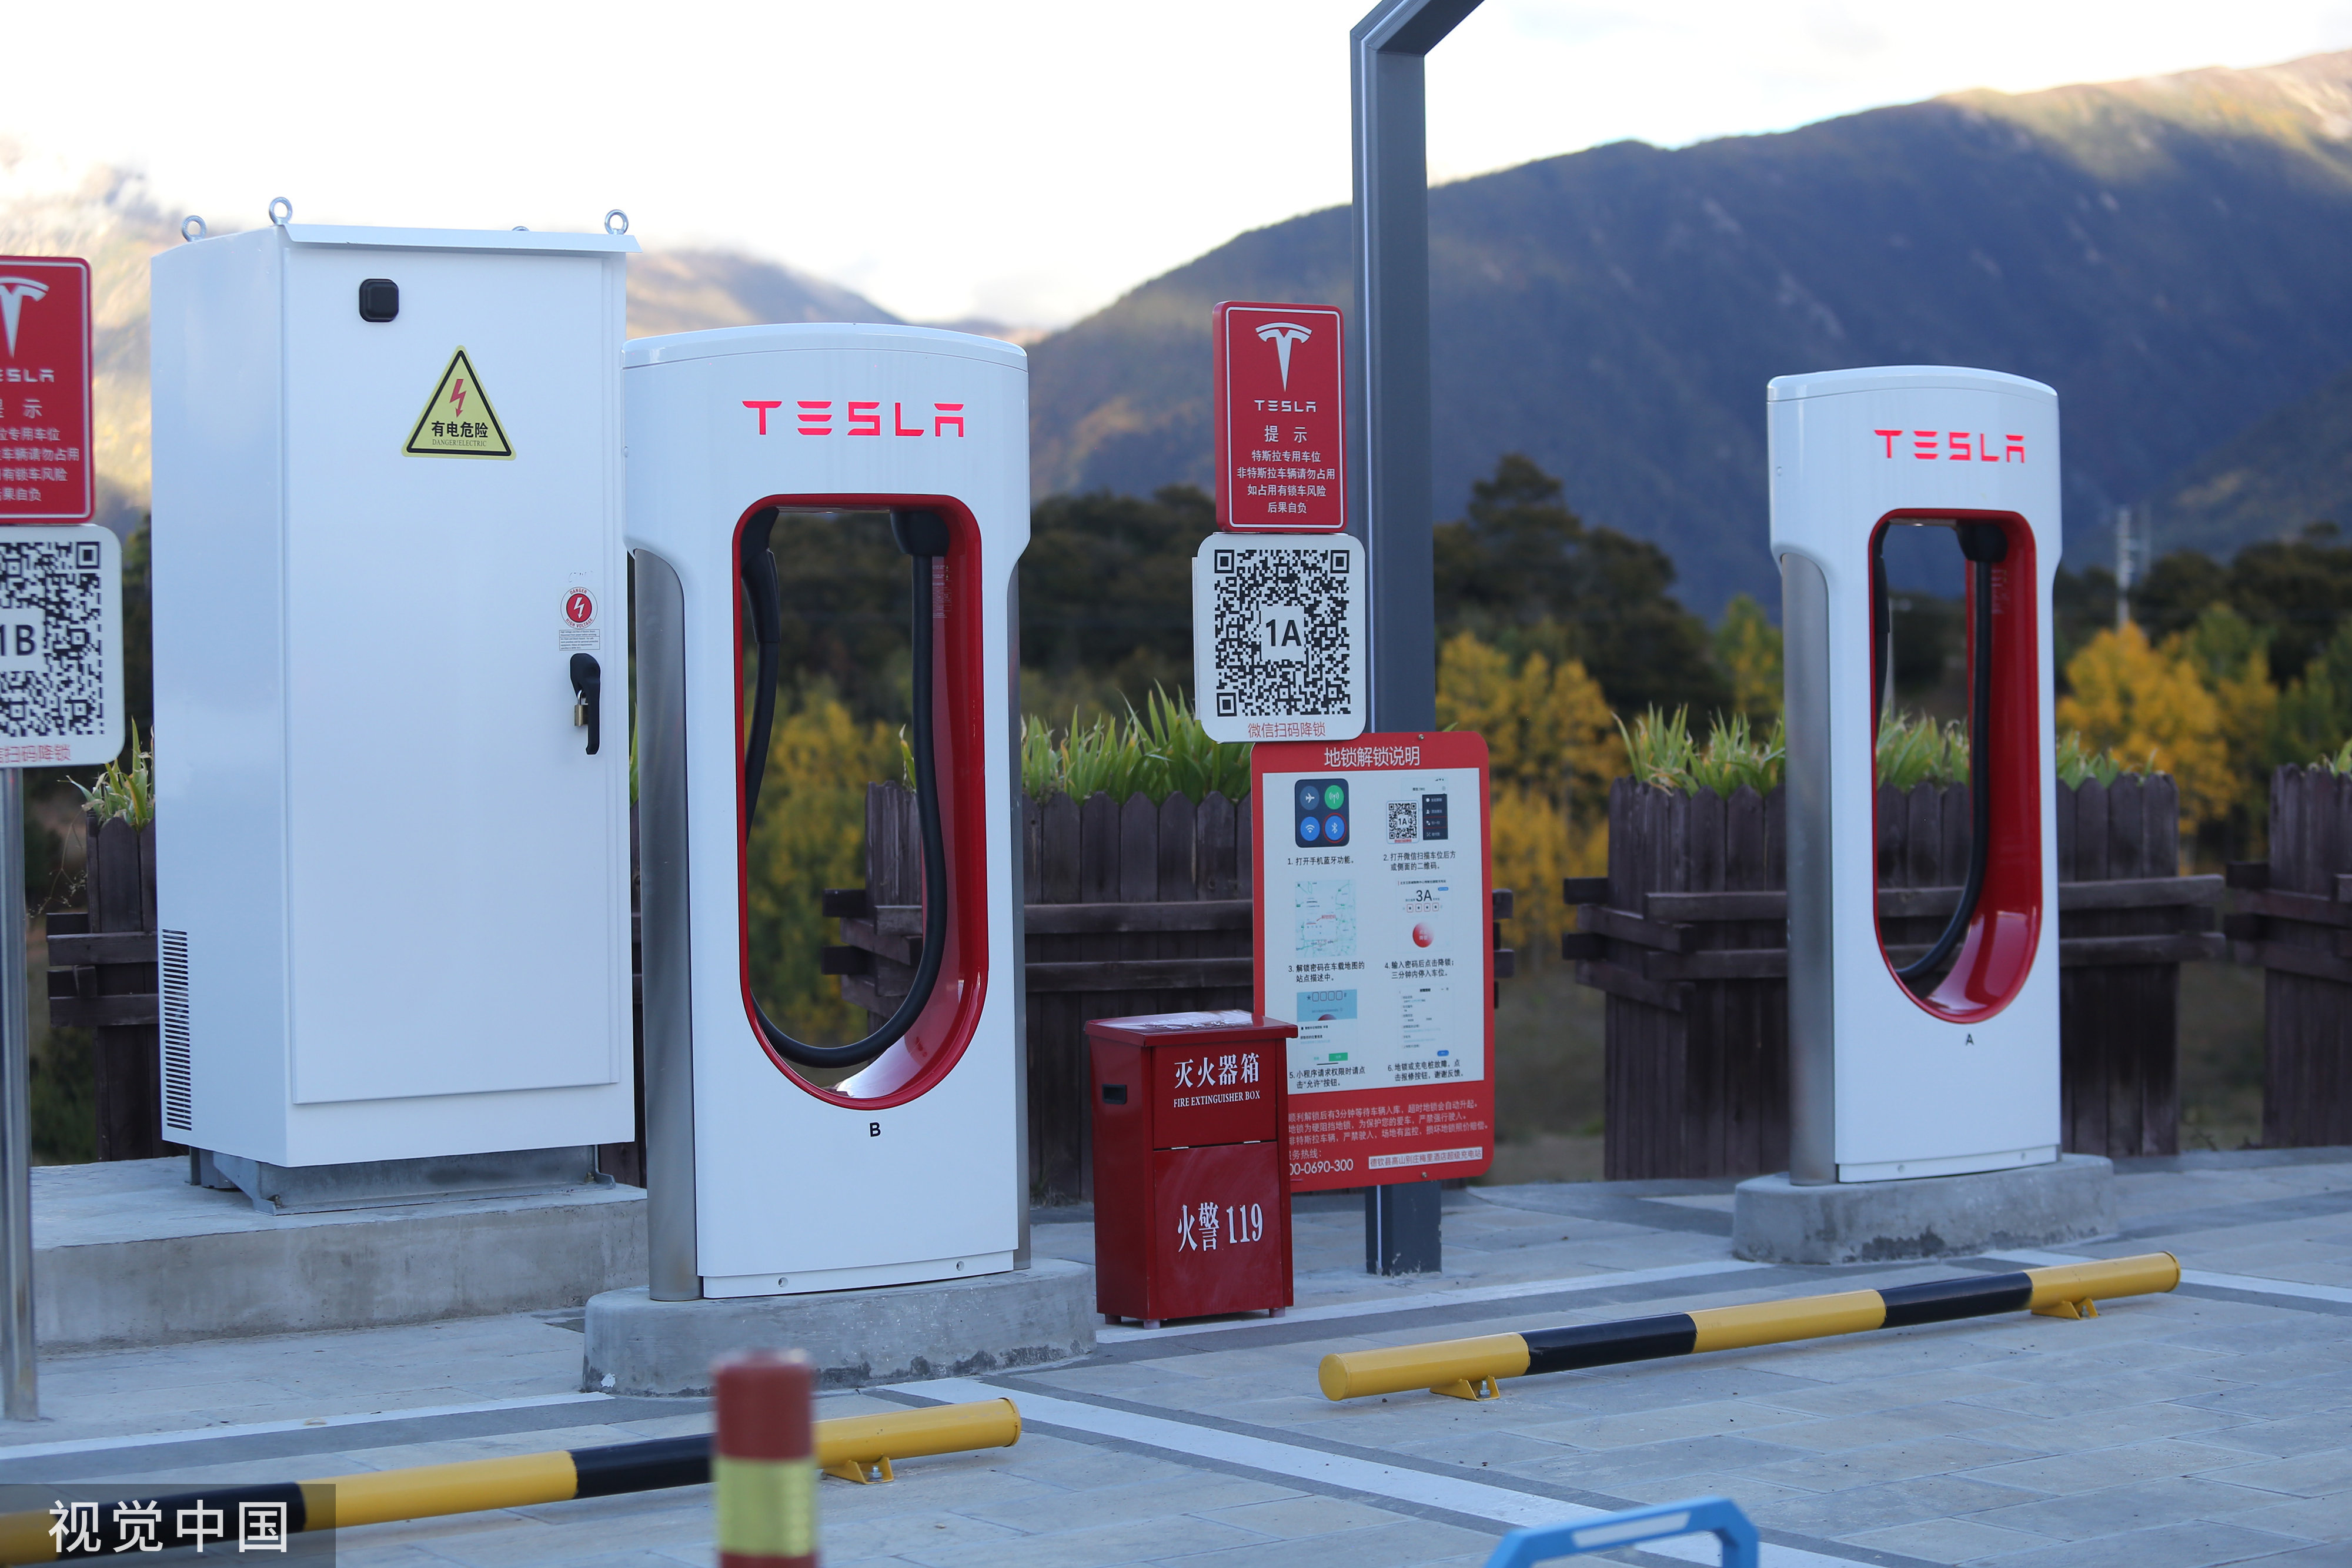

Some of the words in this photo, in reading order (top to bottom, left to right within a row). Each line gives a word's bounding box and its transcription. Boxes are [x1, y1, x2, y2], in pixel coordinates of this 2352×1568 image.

[0, 368, 55, 382] SLA
[0, 399, 42, 419] 示
[1254, 400, 1317, 412] TESLA
[742, 400, 964, 437] TESLA
[431, 421, 489, 438] 有电危险
[1873, 430, 2025, 463] TESLA
[0, 447, 79, 461] 车辆请勿占用
[1252, 450, 1321, 463] 特斯拉专用车位
[0, 467, 68, 481] 有锁车风险
[1237, 467, 1335, 480] 非特斯拉车辆请勿占用
[0, 487, 42, 502] 果自负
[1247, 484, 1327, 497] 如占用有锁车风险
[1268, 502, 1307, 513] 后果自负
[566, 618, 576, 627] HIGH
[576, 617, 593, 628] VOLTAGE
[1265, 619, 1302, 647] 1A
[1248, 721, 1326, 738] 微信扫码降锁
[0, 744, 71, 763] 扫码降锁
[1324, 745, 1421, 767] 地锁解锁说明
[1391, 851, 1456, 861] 打开微信扫描车位后方
[1416, 890, 1432, 902] 3A
[1296, 961, 1365, 973] 解锁密码在车载地图的
[1966, 1034, 1975, 1045] A
[1174, 1052, 1260, 1089] 灭火器箱
[1296, 1065, 1365, 1079] 小程序请求权限时请点
[1174, 1098, 1190, 1108] FIRE
[1191, 1092, 1244, 1106] EXTINGUISHER
[1245, 1091, 1261, 1101] BOX
[870, 1122, 881, 1137] B
[1370, 1149, 1482, 1168] 德钦县高山别庄梅里酒店超级充电站
